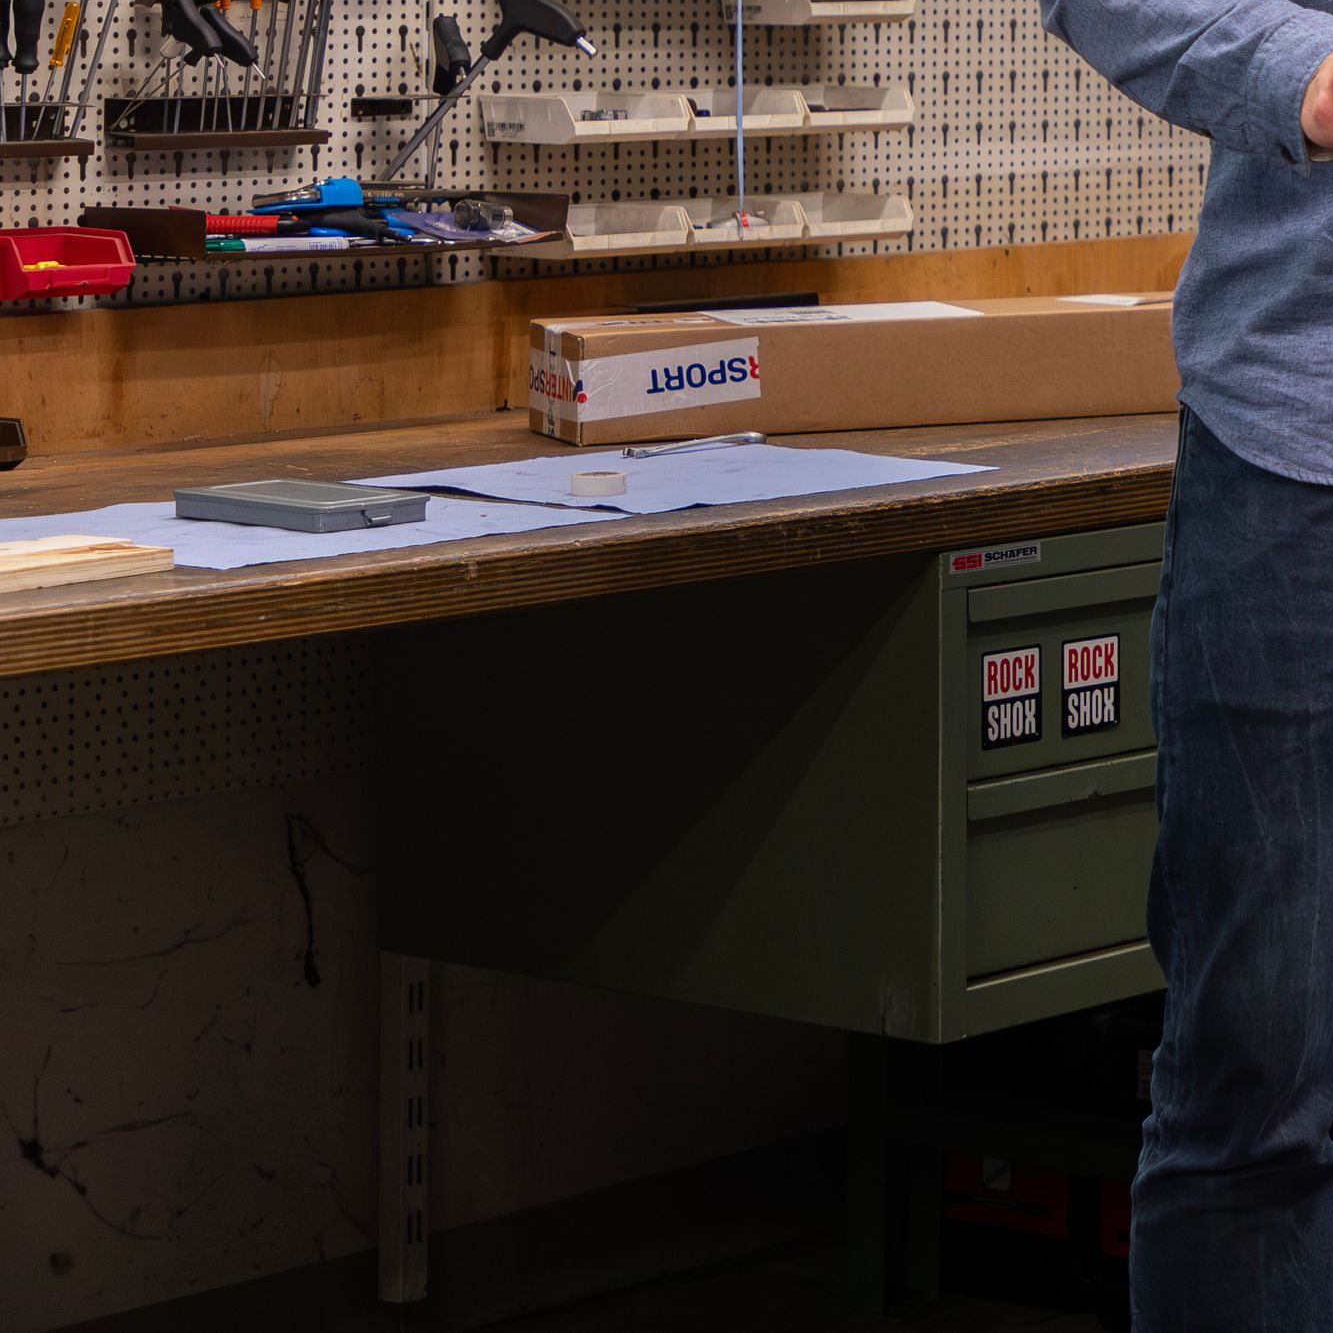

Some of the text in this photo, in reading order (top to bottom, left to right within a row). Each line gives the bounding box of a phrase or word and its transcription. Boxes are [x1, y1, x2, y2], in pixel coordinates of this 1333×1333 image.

[987, 653, 1036, 695] ROCK
[1068, 642, 1115, 683] ROCK
[987, 698, 1037, 742] SHOX
[1067, 686, 1116, 729] SHOX
